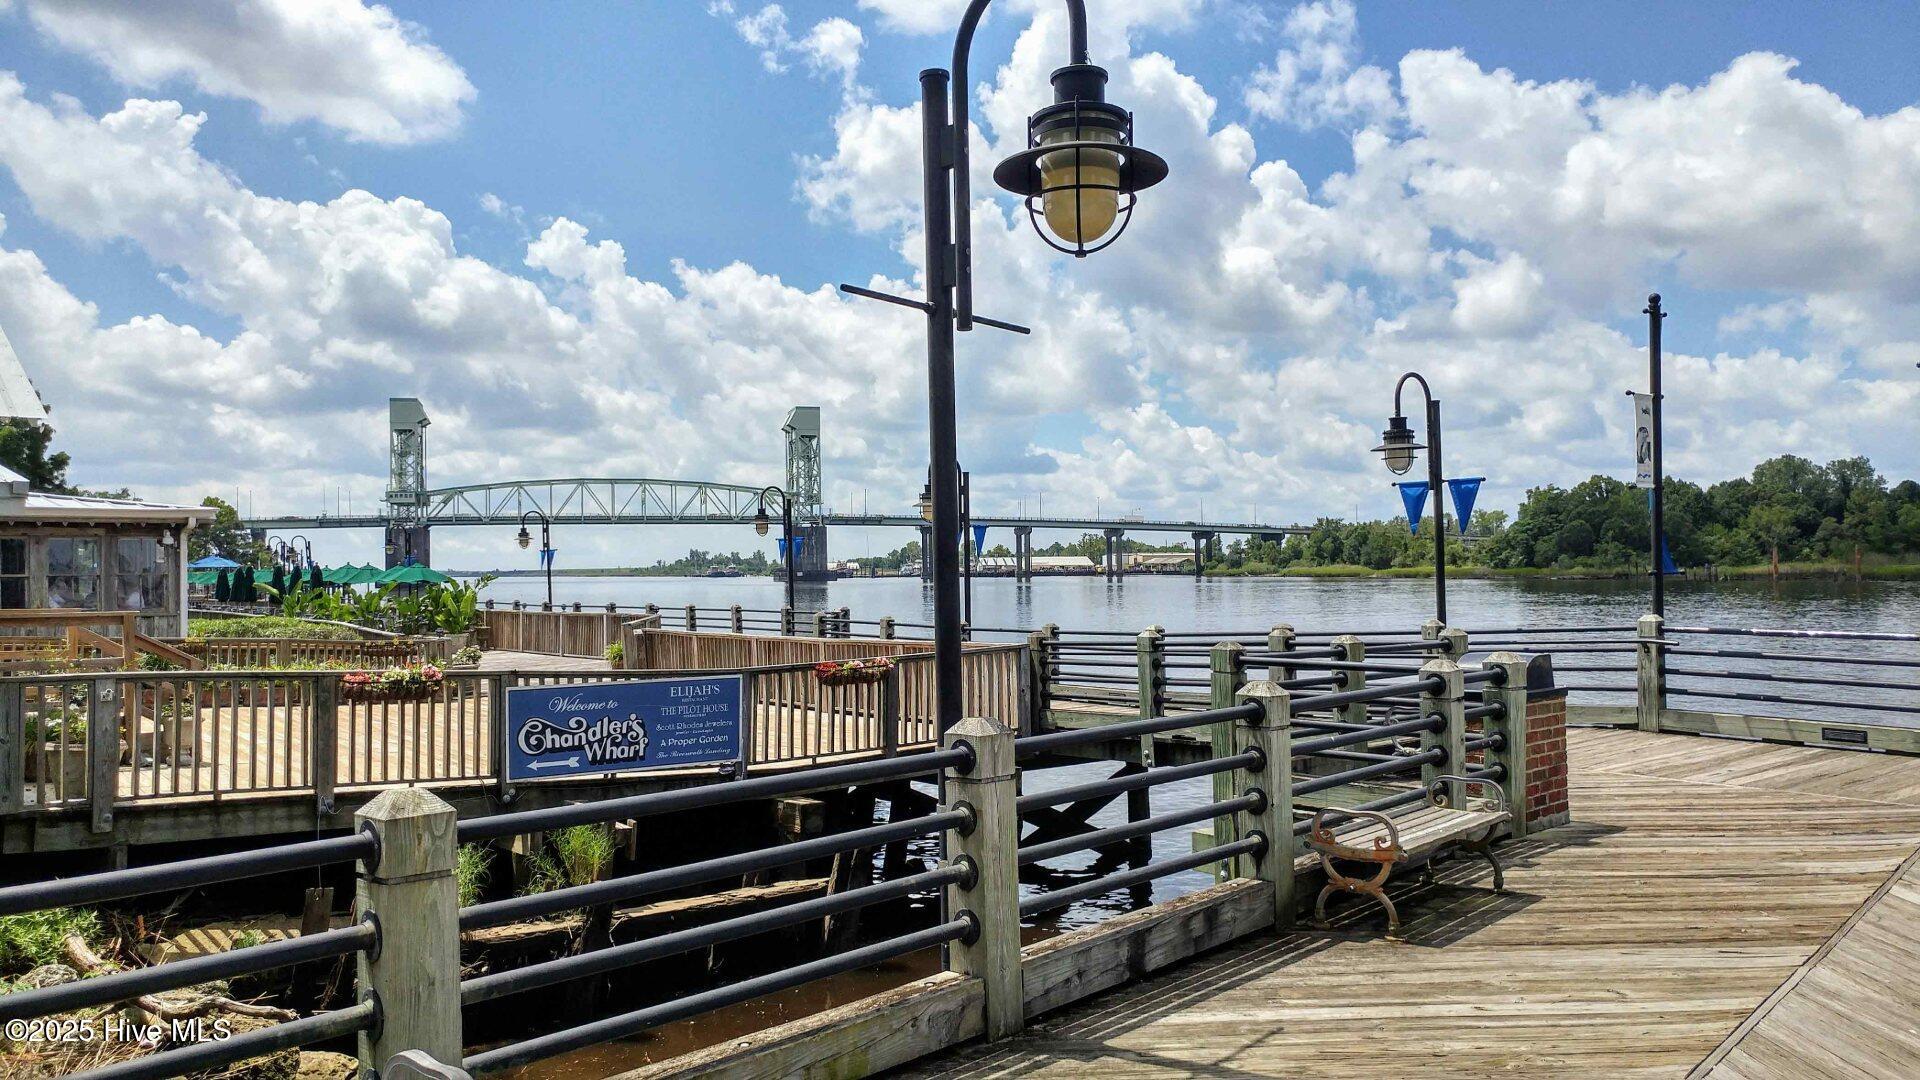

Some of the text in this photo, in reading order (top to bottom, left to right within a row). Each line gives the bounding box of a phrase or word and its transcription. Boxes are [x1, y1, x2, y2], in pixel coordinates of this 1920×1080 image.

[670, 684, 720, 697] ELIJAH'S
[548, 693, 619, 713] Welcome to
[661, 704, 729, 715] THE PILOT HOUSE
[656, 724, 675, 732] Scott
[676, 722, 703, 730] Rhodes
[705, 719, 733, 728] Jewelers
[518, 713, 645, 755] Chandler's
[660, 734, 729, 747] A Proper Garden
[584, 734, 649, 761] Wharf
[656, 751, 669, 759] The
